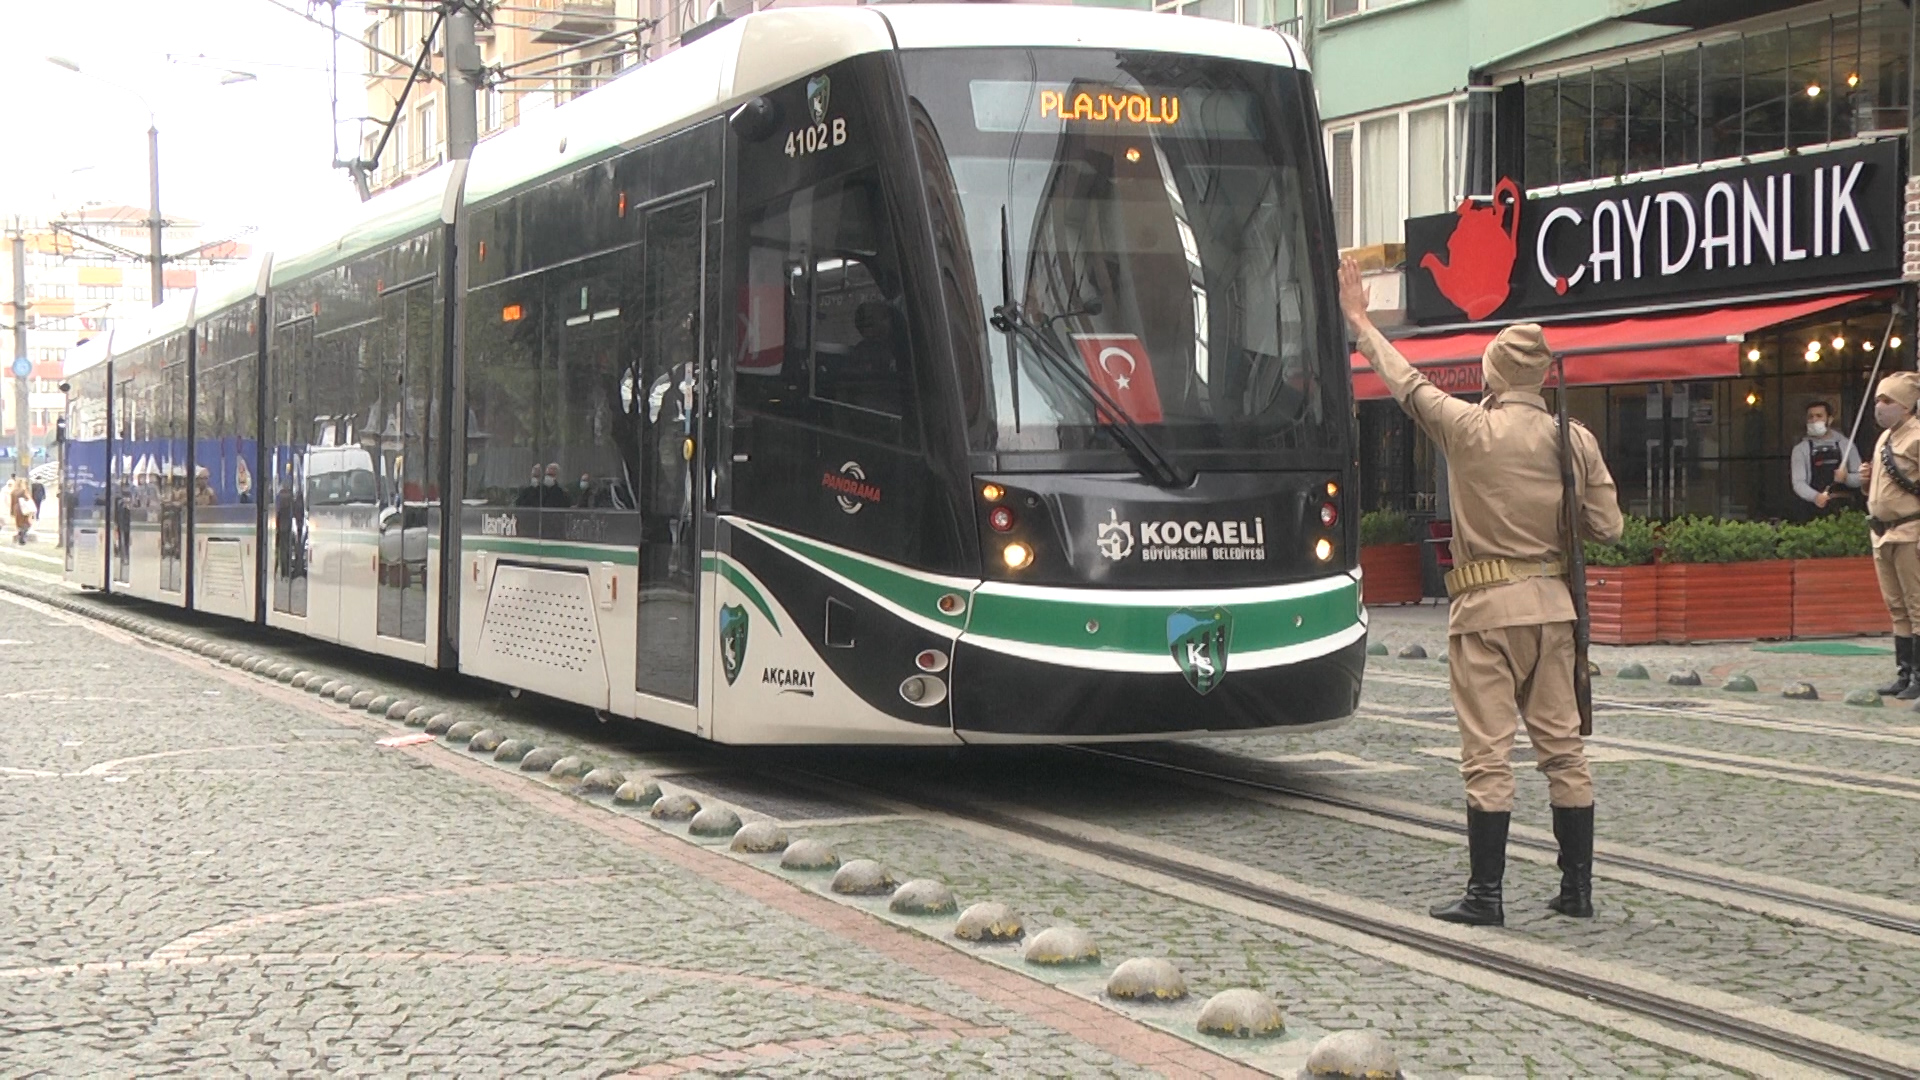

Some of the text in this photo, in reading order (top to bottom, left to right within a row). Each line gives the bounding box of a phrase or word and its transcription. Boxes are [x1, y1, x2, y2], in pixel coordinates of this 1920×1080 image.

[1040, 90, 1179, 125] PLAJYOLU
[784, 116, 848, 158] 4102 B
[1536, 160, 1871, 296] ÇAYDANLIK
[822, 472, 882, 503] PANORAMA
[1140, 517, 1265, 545] KOCAELİ
[1142, 545, 1266, 561] BÜYÜKŞEHİR BELEDİYESİ
[761, 667, 815, 688] AKÇARAY
